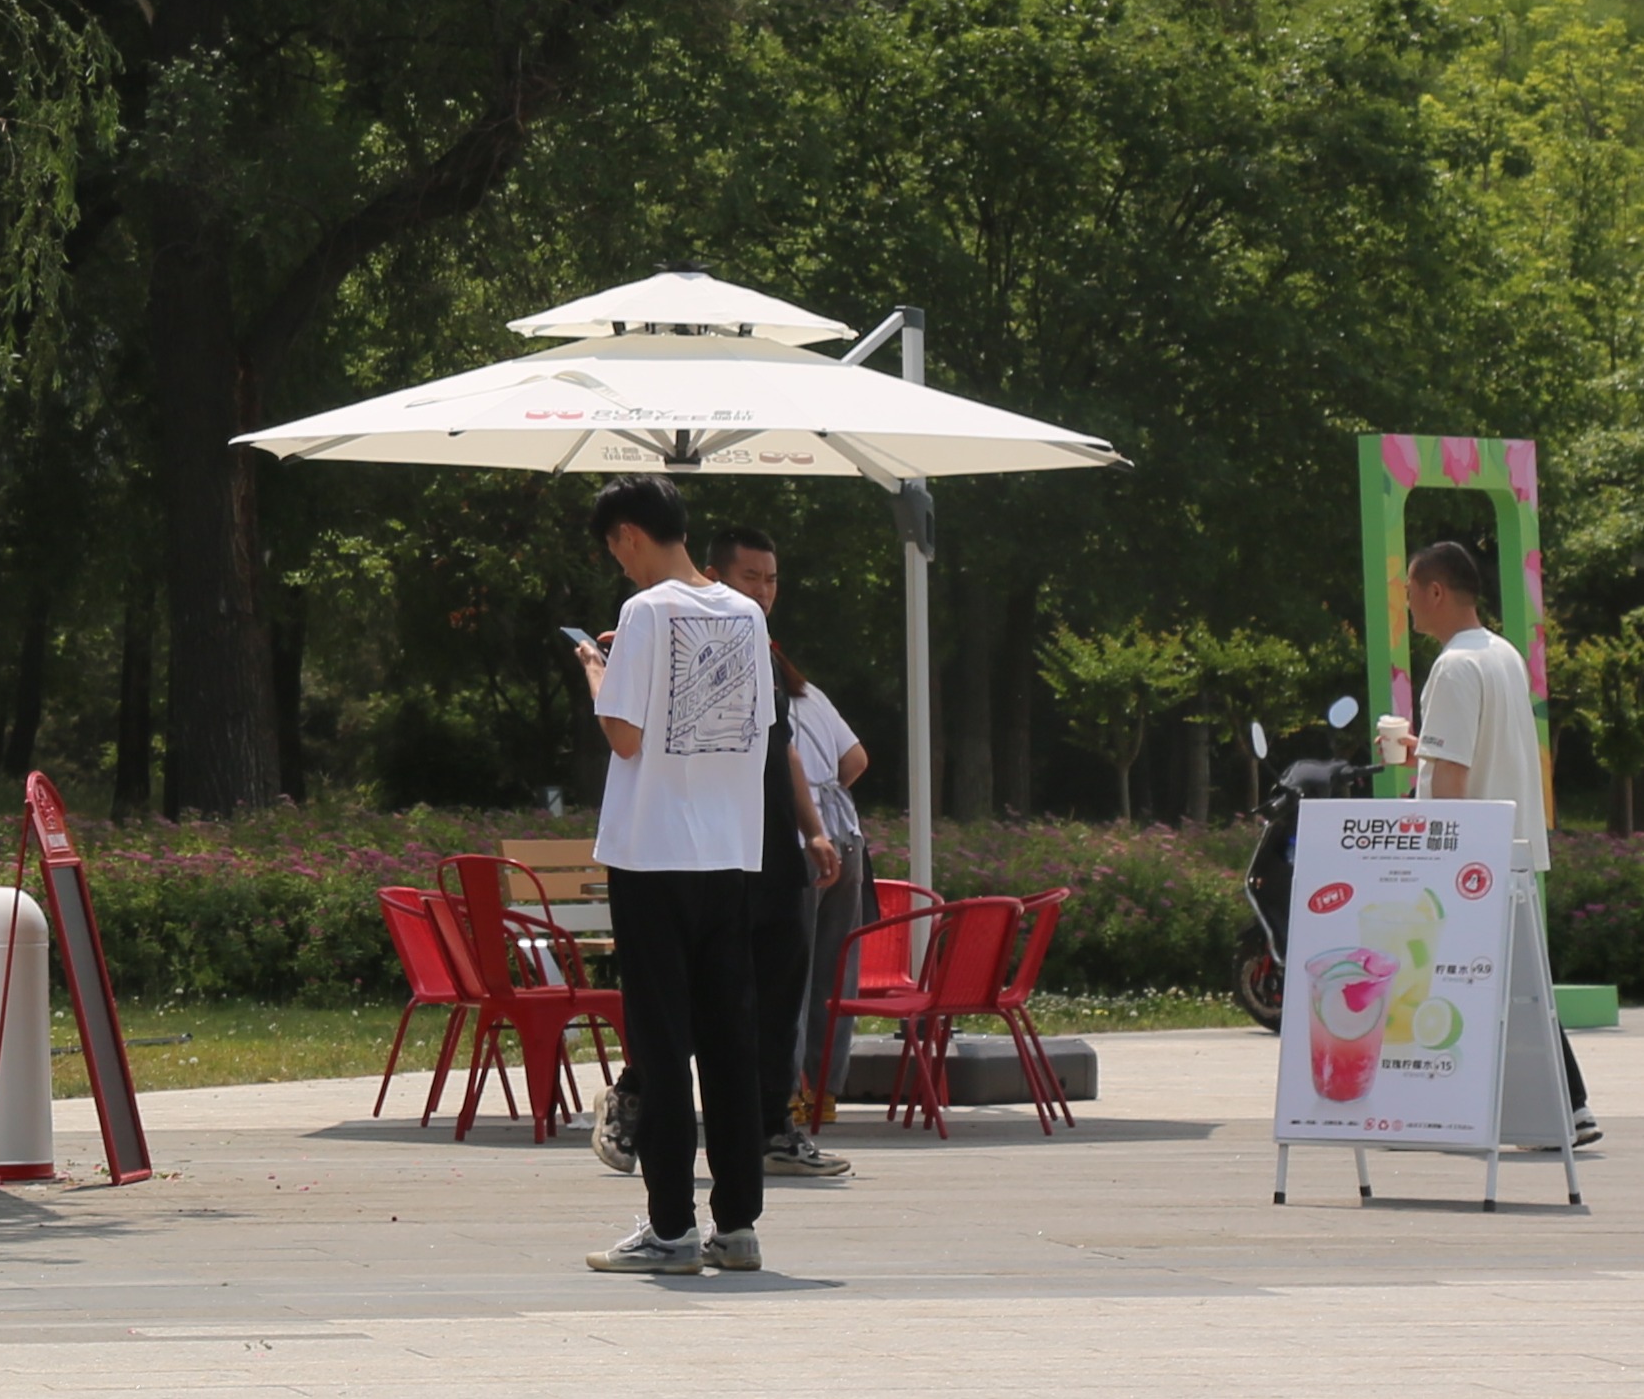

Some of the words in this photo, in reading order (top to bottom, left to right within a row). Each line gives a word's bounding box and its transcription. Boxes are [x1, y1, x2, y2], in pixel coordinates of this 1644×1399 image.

[1343, 819, 1399, 833] RUBY
[1430, 820, 1460, 836] 鲁比
[1341, 835, 1422, 850] COFFEE
[1427, 837, 1458, 851] 咖啡
